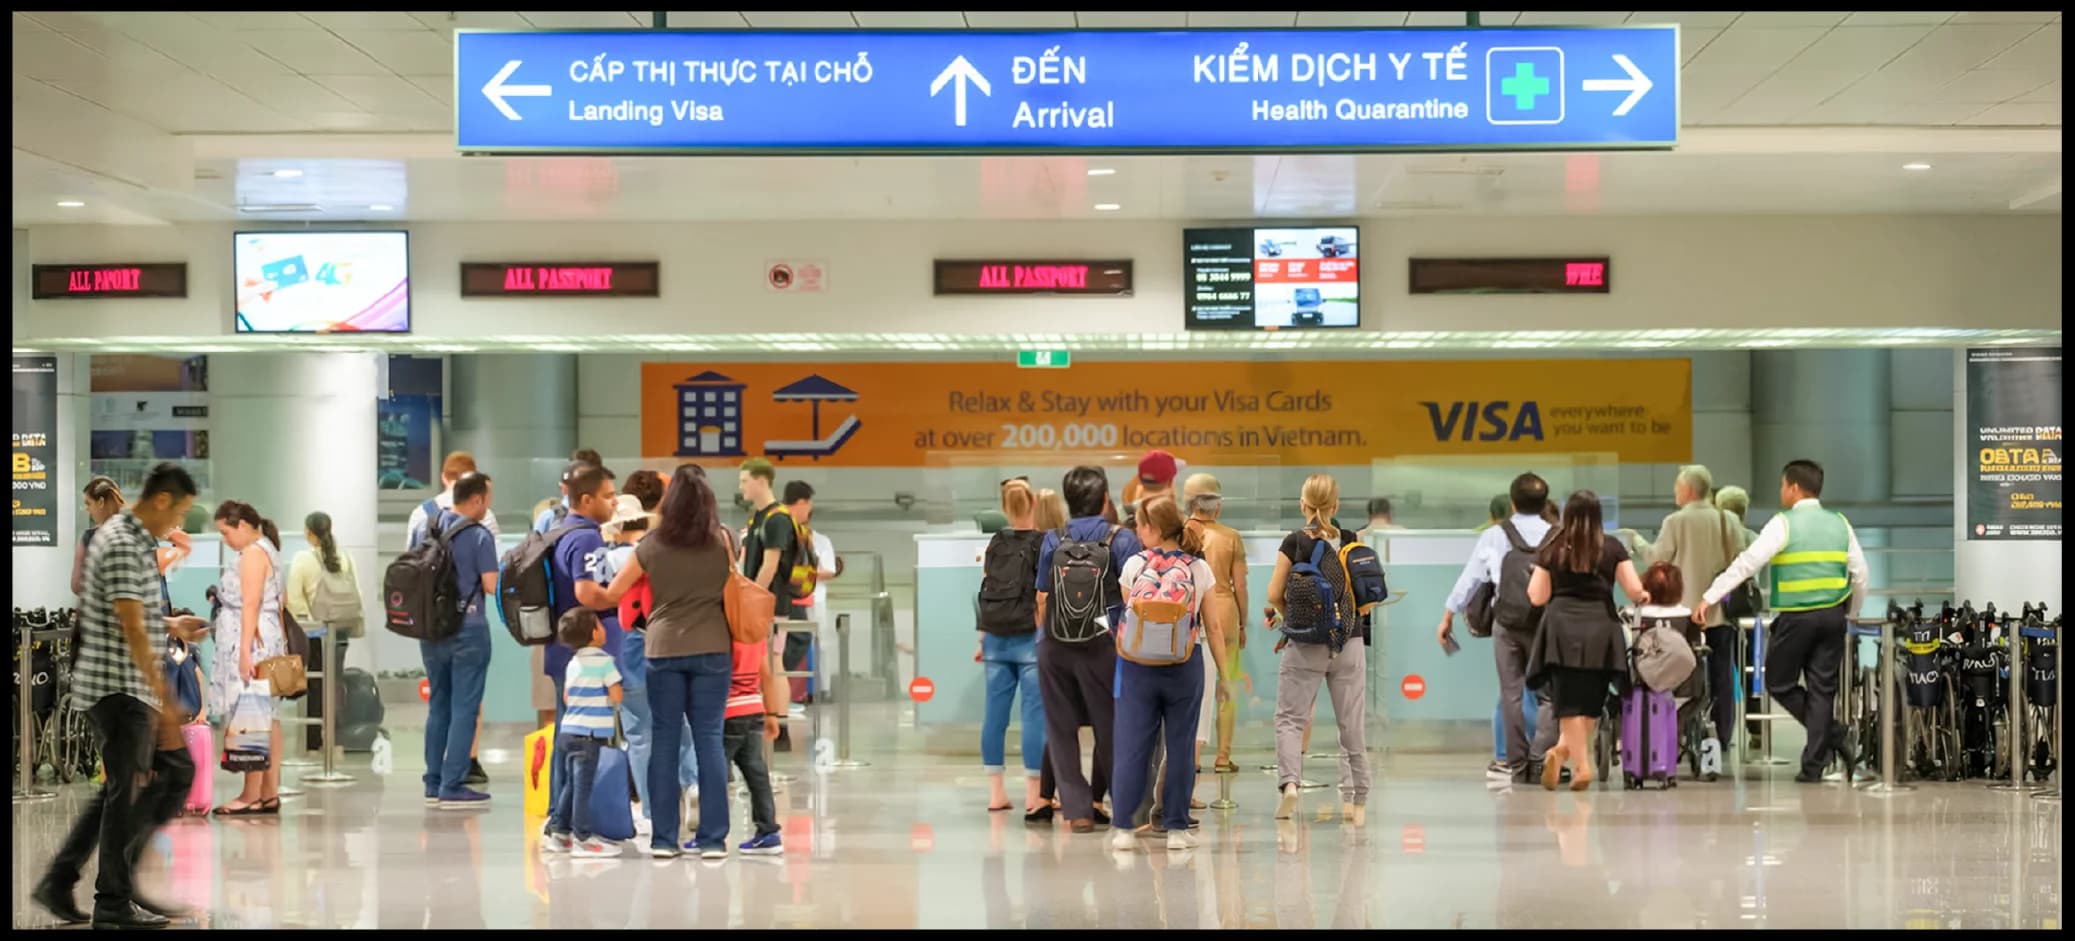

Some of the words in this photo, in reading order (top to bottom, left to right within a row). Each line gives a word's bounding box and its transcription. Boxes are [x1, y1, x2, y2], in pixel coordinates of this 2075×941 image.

[569, 52, 625, 83] CẤP
[632, 60, 675, 86] THỊ
[683, 58, 756, 86] THỰC
[765, 61, 806, 86] TẠI
[814, 51, 873, 83] CHỖ
[1012, 45, 1086, 84] ĐẾN
[1194, 41, 1279, 83] KIỂM
[1291, 53, 1376, 87] DỊCH
[1388, 53, 1411, 81] Y
[1422, 42, 1467, 81] TẾ
[569, 100, 663, 126] Landing
[671, 100, 724, 121] Visa
[1012, 101, 1114, 128] Arrival
[1252, 99, 1328, 121] Health
[1335, 98, 1469, 122] Quarantine
[69, 270, 92, 291] ALL
[504, 267, 535, 290] ALL
[979, 265, 1011, 288] ALL
[1013, 265, 1089, 289] PASSPORT
[949, 391, 1011, 412] Relax
[1017, 391, 1035, 412] &
[1041, 391, 1090, 416] Stay
[1098, 390, 1149, 412] with
[1155, 395, 1208, 417] your
[1213, 390, 1260, 412] Visa
[1265, 389, 1332, 412] Cards
[1549, 404, 1645, 421] everywhere
[1418, 401, 1544, 441] VISA
[1552, 422, 1583, 437] you
[1586, 419, 1625, 434] want
[1630, 420, 1648, 434] to
[1651, 420, 1672, 434] be
[914, 429, 936, 448] at
[942, 431, 995, 448] over
[1000, 423, 1119, 452] 200,000
[1122, 424, 1233, 447] locations
[1240, 425, 1260, 447] in
[1262, 424, 1368, 447] Vietnam.
